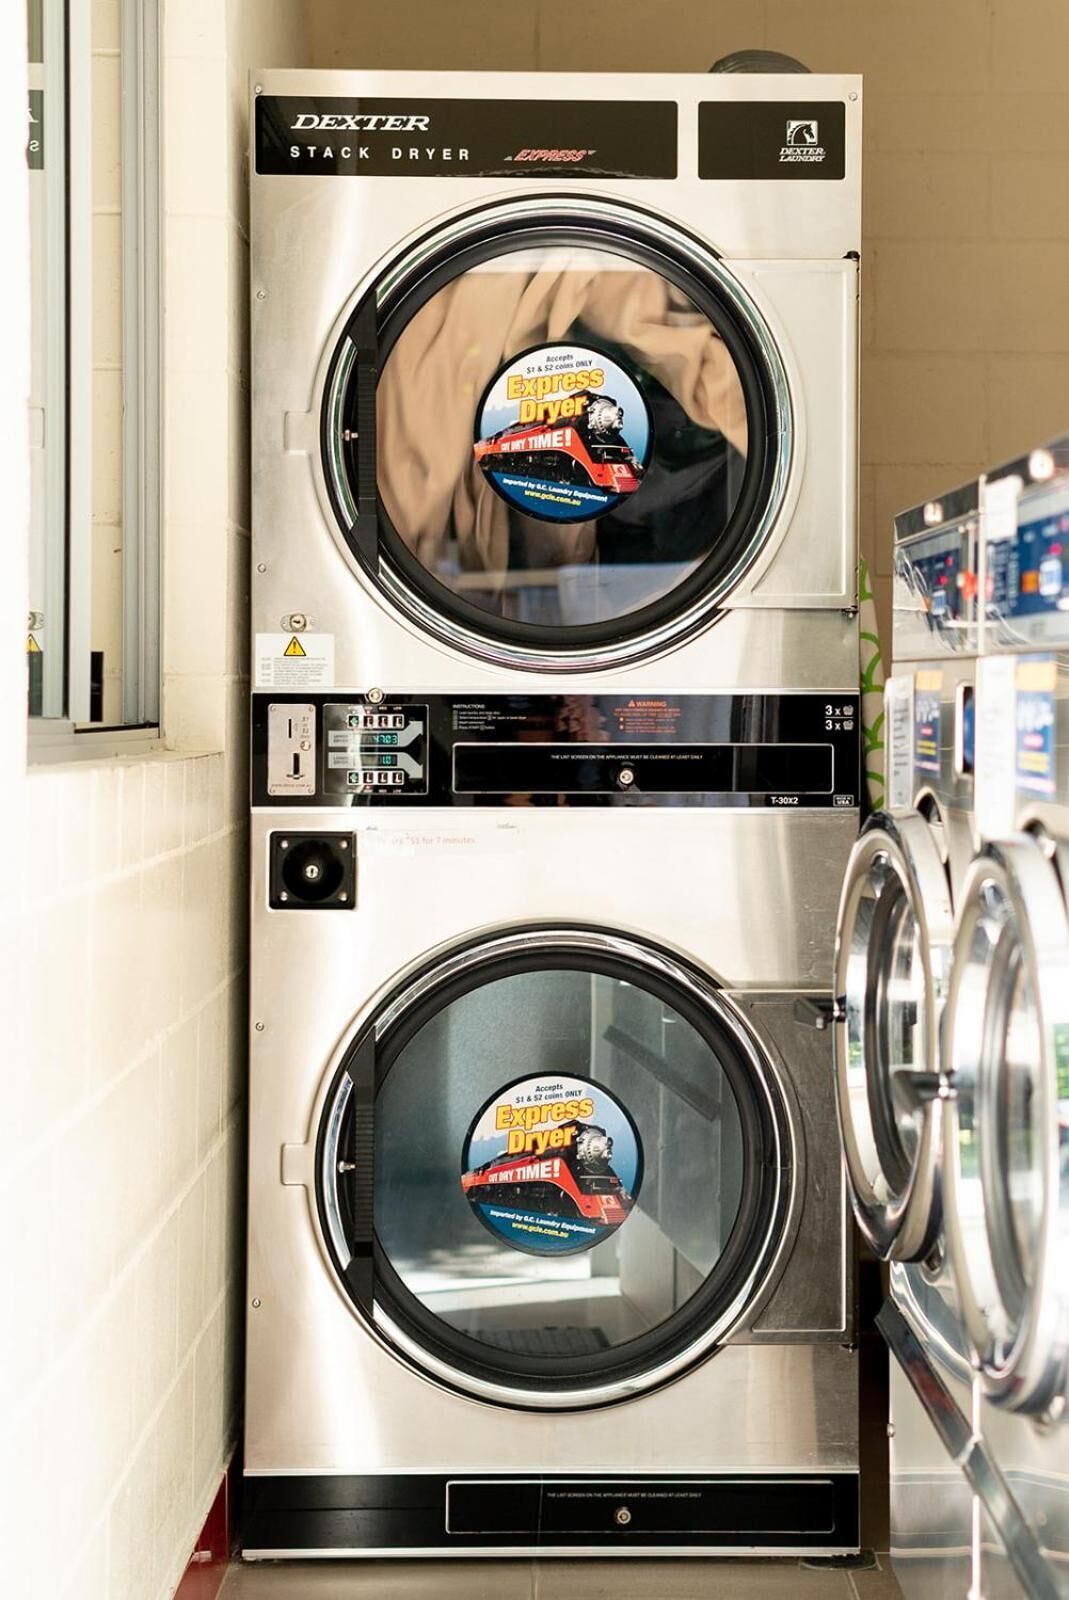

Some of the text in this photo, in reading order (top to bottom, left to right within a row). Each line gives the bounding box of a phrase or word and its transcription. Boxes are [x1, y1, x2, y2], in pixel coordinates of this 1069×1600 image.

[290, 114, 430, 131] DEXTER
[290, 146, 470, 160] STACK DRYER
[513, 149, 587, 162] EXPRESS
[779, 147, 825, 155] DEXTER
[546, 353, 574, 362] Accepts
[575, 359, 592, 368] ONLY
[507, 368, 604, 400] Express
[519, 395, 588, 425] Dryer
[528, 428, 572, 449] TIME!
[548, 486, 572, 496] Laundry
[573, 489, 608, 502] Equipment
[825, 705, 841, 716] 3 x
[825, 720, 833, 731] 3
[770, 796, 799, 805] T-30X2
[535, 1083, 563, 1092] Accepts
[565, 1089, 582, 1098] ONLY
[496, 1098, 593, 1130] Express
[508, 1126, 577, 1155] Dryer
[516, 1159, 560, 1180] TIME!
[536, 1218, 561, 1228] Laundry
[561, 1221, 597, 1234] Equipment
